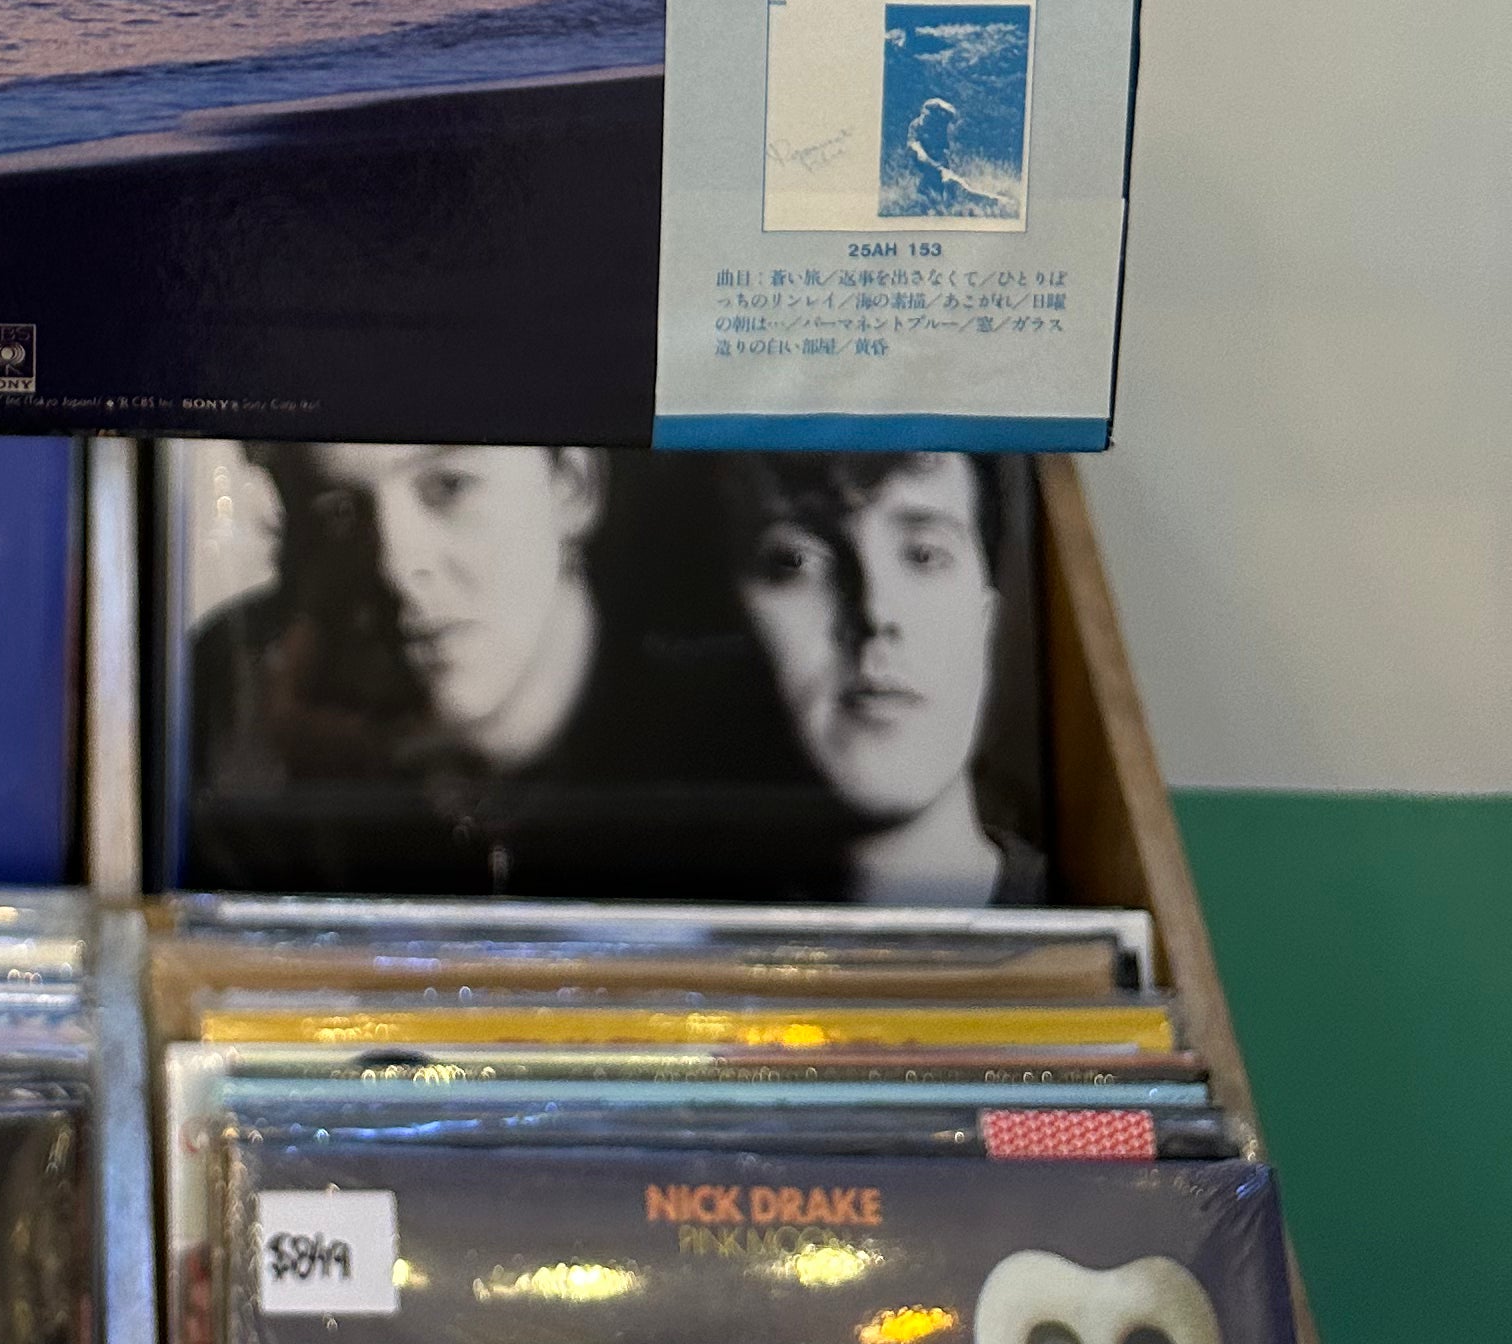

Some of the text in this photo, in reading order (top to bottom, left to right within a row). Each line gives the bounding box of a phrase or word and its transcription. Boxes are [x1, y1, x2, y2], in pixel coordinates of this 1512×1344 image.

[848, 242, 943, 258] 25AH 153
[644, 1183, 884, 1226] NICK DRAKE
[265, 1231, 352, 1282] $849
